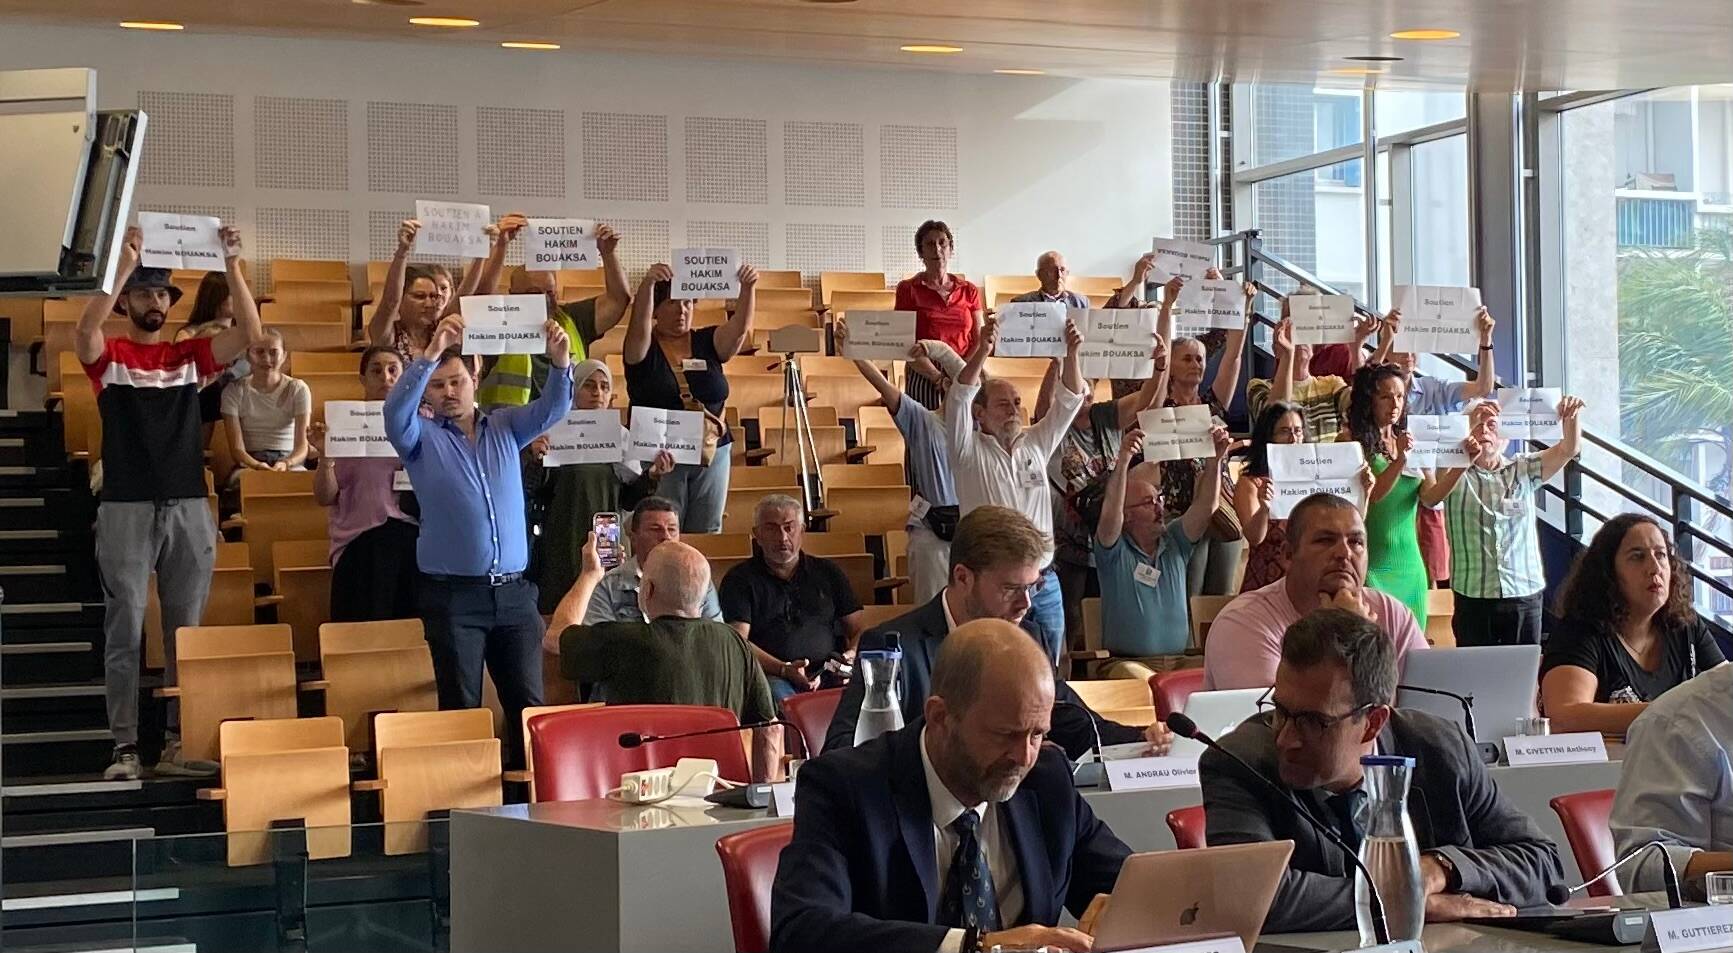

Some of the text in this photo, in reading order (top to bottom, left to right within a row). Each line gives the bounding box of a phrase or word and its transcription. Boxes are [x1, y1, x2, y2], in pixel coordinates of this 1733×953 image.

[432, 220, 470, 231] HAKIM
[538, 226, 583, 235] SOUTIEN
[428, 232, 482, 244] BOUAKSA
[544, 240, 578, 248] HAKIM
[536, 253, 587, 262] BOUAKSA
[684, 256, 728, 264] SOUTIEN
[690, 270, 722, 278] HAKIM
[680, 282, 730, 291] BOUAKSA
[1310, 486, 1352, 494] BOUAKSA
[1136, 770, 1170, 778] ANDRAU
[1172, 768, 1197, 776] Olivier
[1667, 930, 1680, 940] M.
